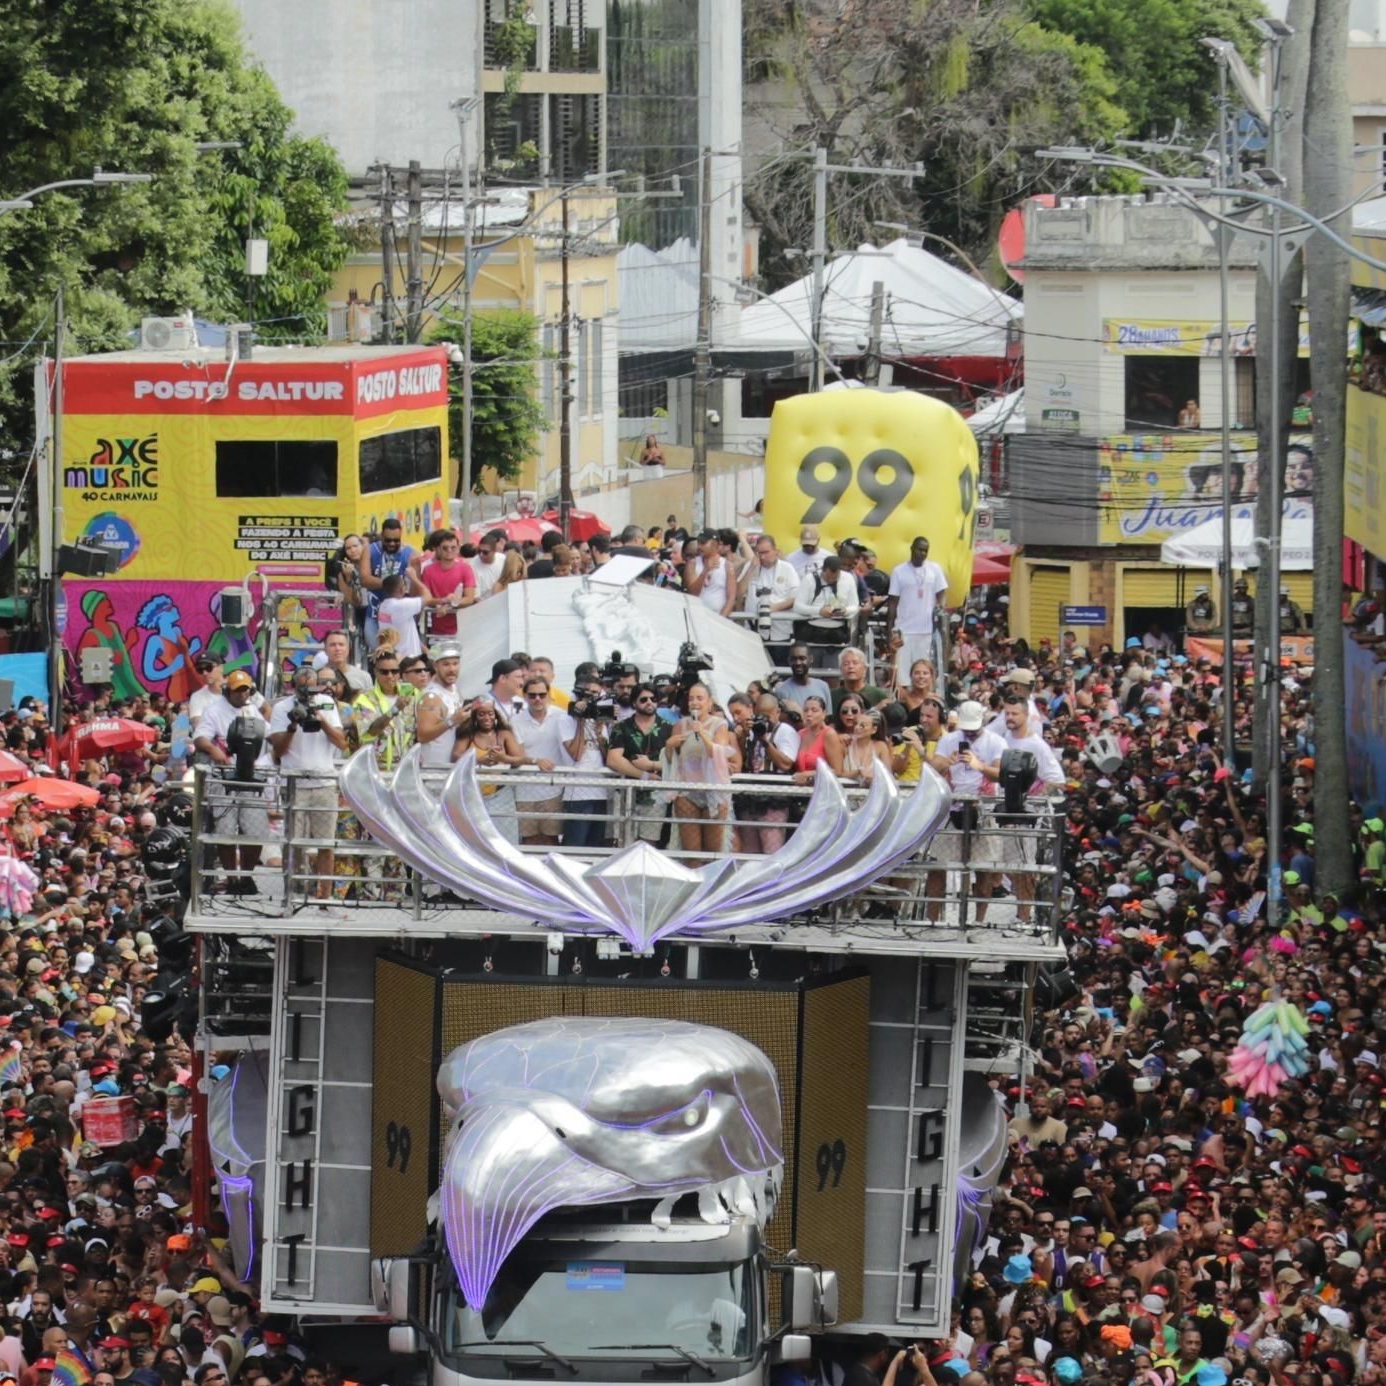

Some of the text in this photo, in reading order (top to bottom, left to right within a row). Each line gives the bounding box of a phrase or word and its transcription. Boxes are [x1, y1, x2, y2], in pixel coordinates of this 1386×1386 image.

[134, 380, 343, 400] POSTO SALTUR
[357, 364, 442, 405] POSTO SALTUR
[90, 433, 158, 465] axé
[64, 461, 158, 488] music
[797, 446, 914, 527] 99
[82, 492, 158, 502] 40 CARNAVAIS
[241, 529, 335, 537] FAZENDO A FESTA
[304, 516, 332, 526] VOCÊ
[237, 541, 261, 549] NOS
[263, 541, 278, 549] 40
[251, 550, 326, 560] DO AXÉ MUSIC
[283, 938, 313, 1287] LIGHT
[386, 1121, 411, 1174] 99
[909, 962, 946, 1311] LIGHT
[816, 1138, 846, 1192] 99
